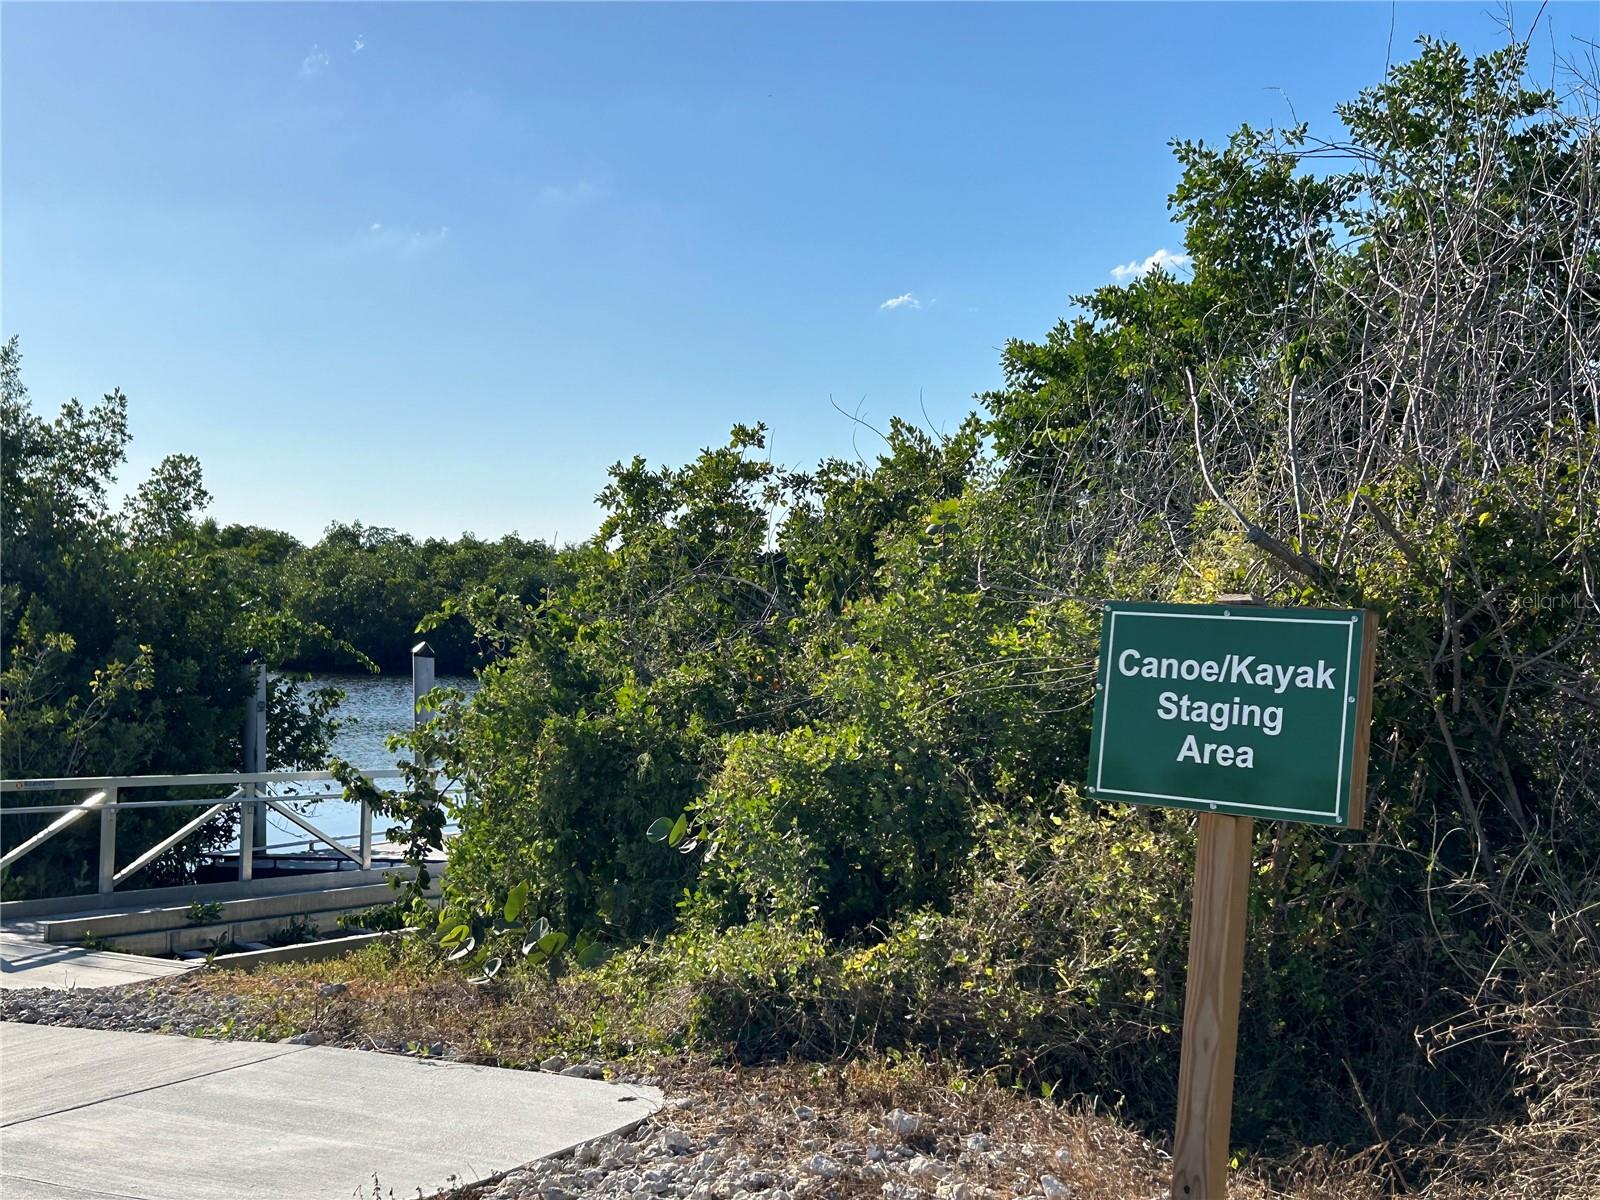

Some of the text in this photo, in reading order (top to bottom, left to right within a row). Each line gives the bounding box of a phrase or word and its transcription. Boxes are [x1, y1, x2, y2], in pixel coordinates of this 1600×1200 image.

[1118, 648, 1336, 694] Canoe/Kayak
[1157, 691, 1284, 736] Staging
[1176, 734, 1254, 769] Area
